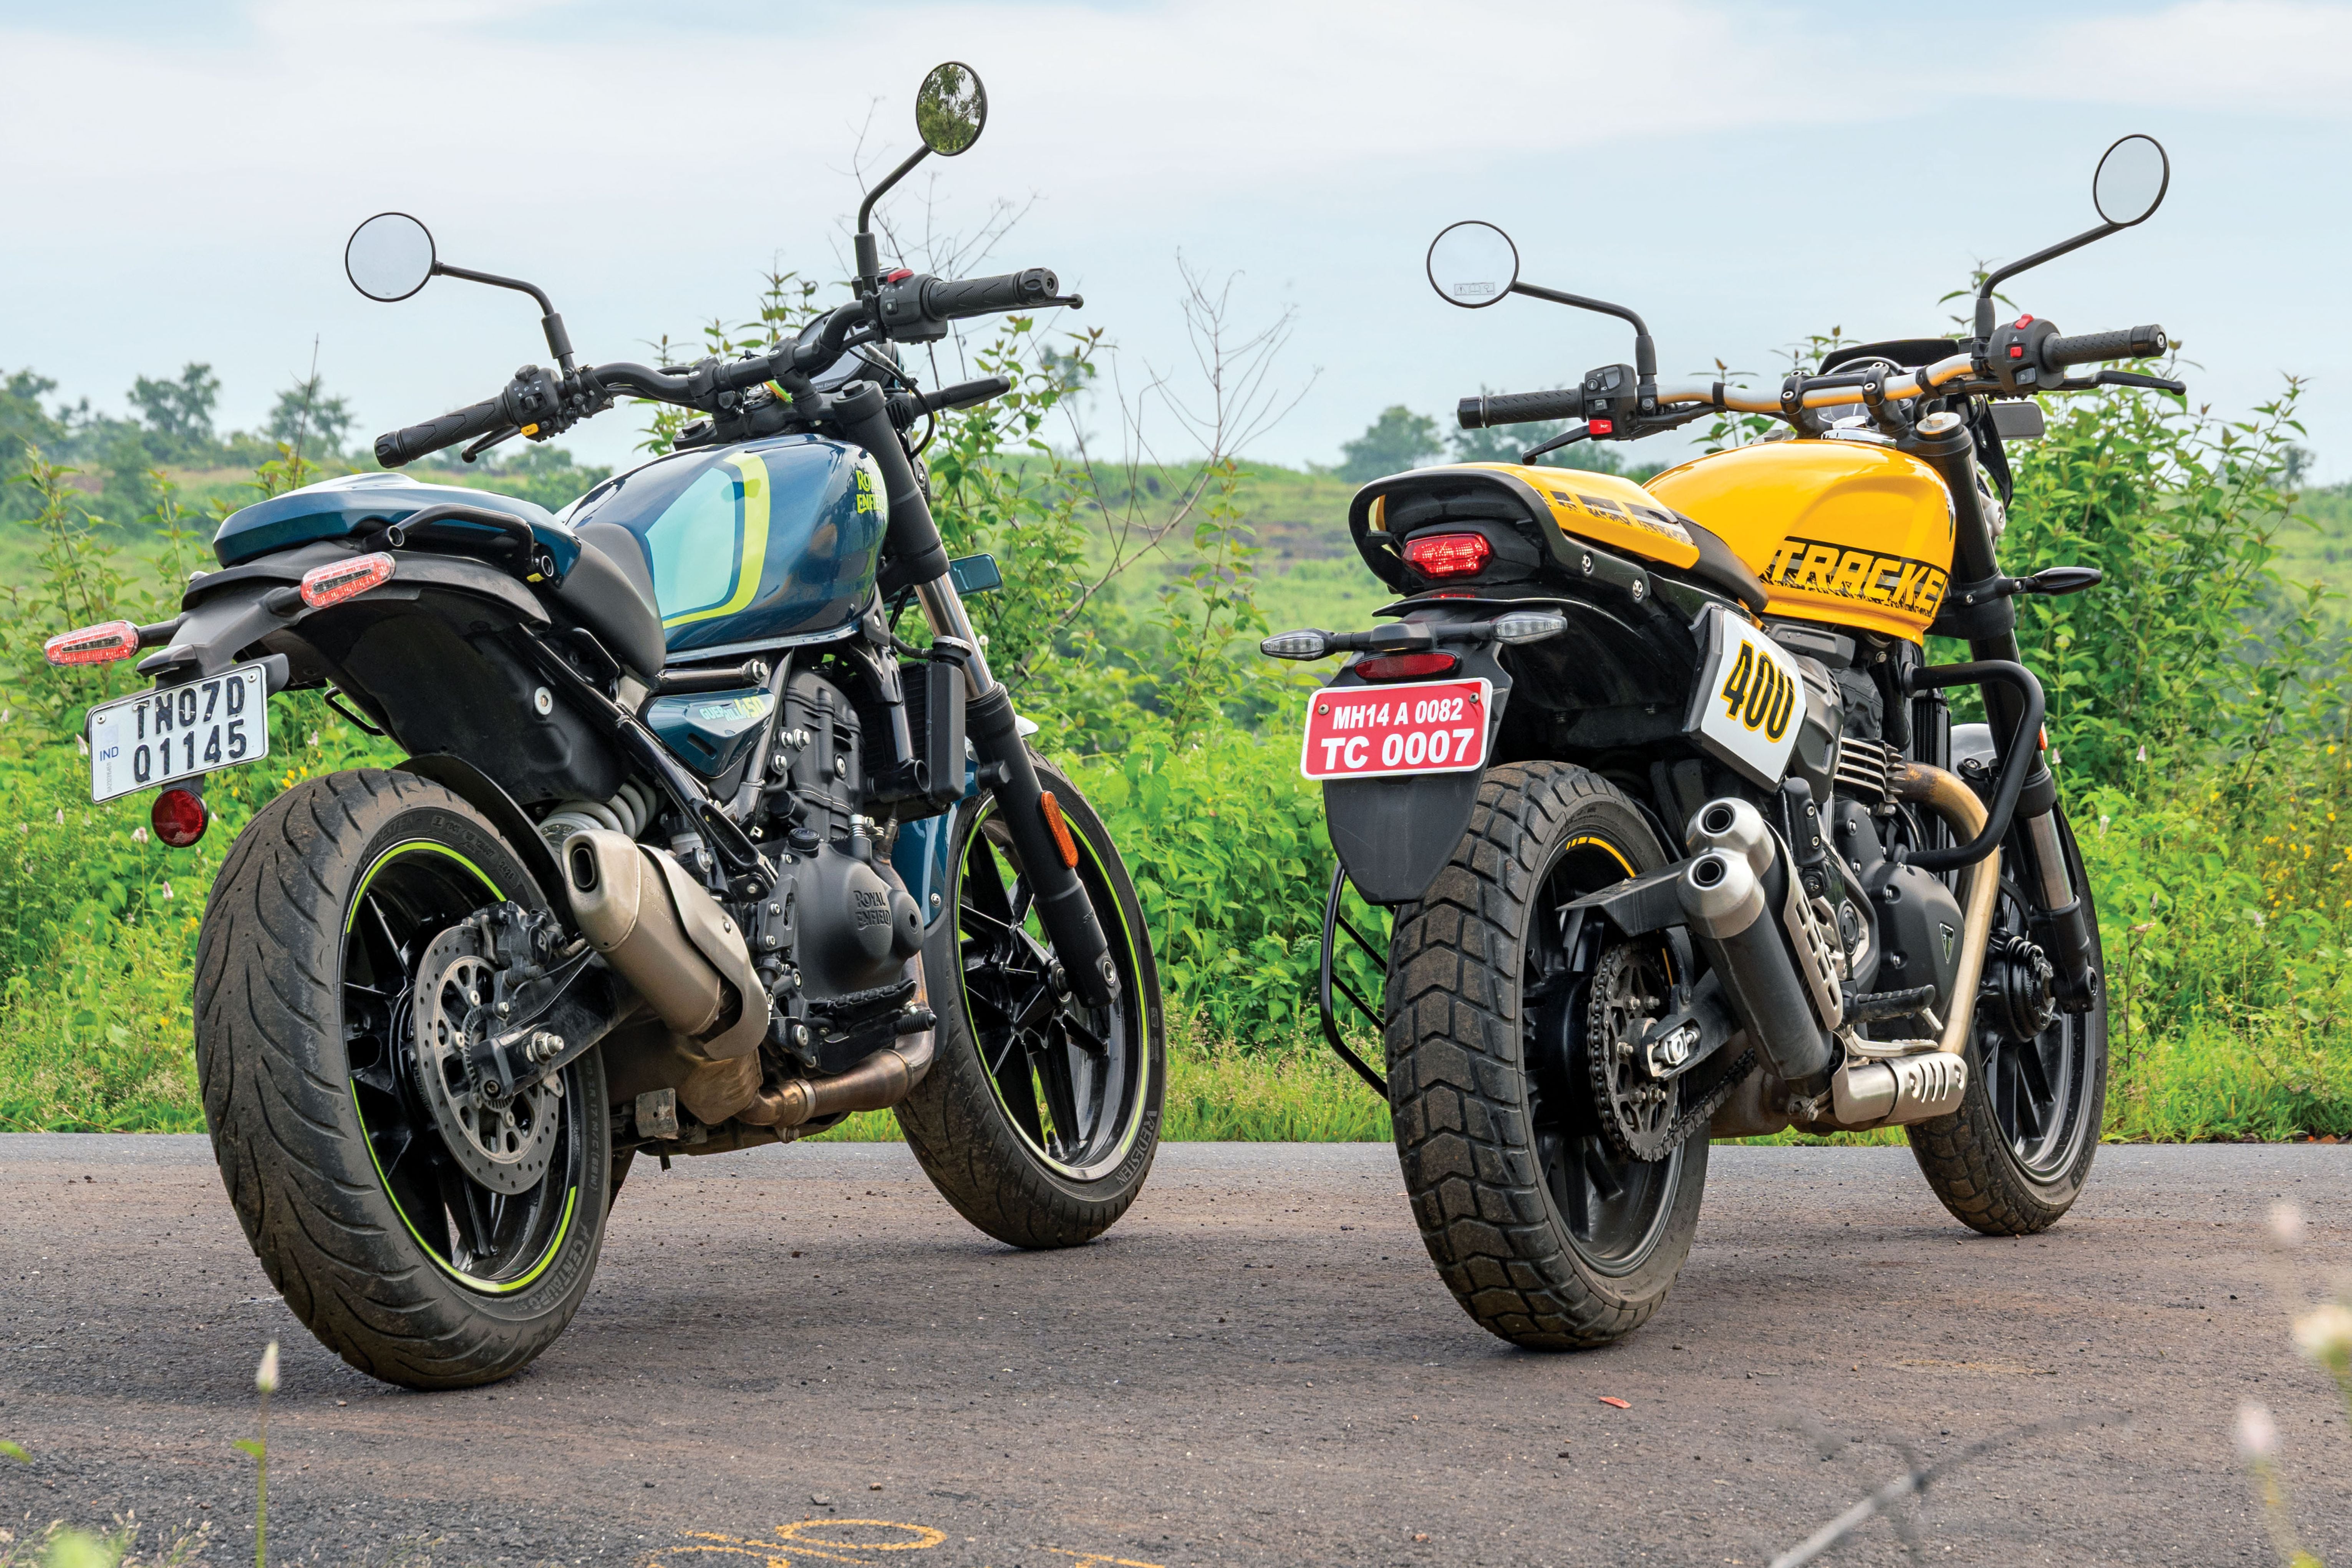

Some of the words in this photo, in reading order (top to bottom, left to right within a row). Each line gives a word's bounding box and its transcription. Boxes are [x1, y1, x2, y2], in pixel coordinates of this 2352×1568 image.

[855, 470, 882, 492] ROYAL
[856, 494, 885, 514] ENFIELD
[1771, 540, 1948, 611] TRACKE
[1720, 639, 1795, 743] 400
[132, 675, 246, 740] TN07D
[733, 696, 766, 719] 450
[1333, 703, 1389, 730] MH14
[1394, 702, 1409, 725] A
[1415, 698, 1464, 724] 0082
[99, 746, 119, 762] IND
[1321, 736, 1370, 770] TC
[1381, 728, 1475, 767] 0007
[854, 890, 886, 909] ROYAL
[855, 910, 892, 930] ENFIELD
[1115, 1109, 1158, 1186] VREDESTEIN
[529, 1239, 587, 1310] CENTAURO
